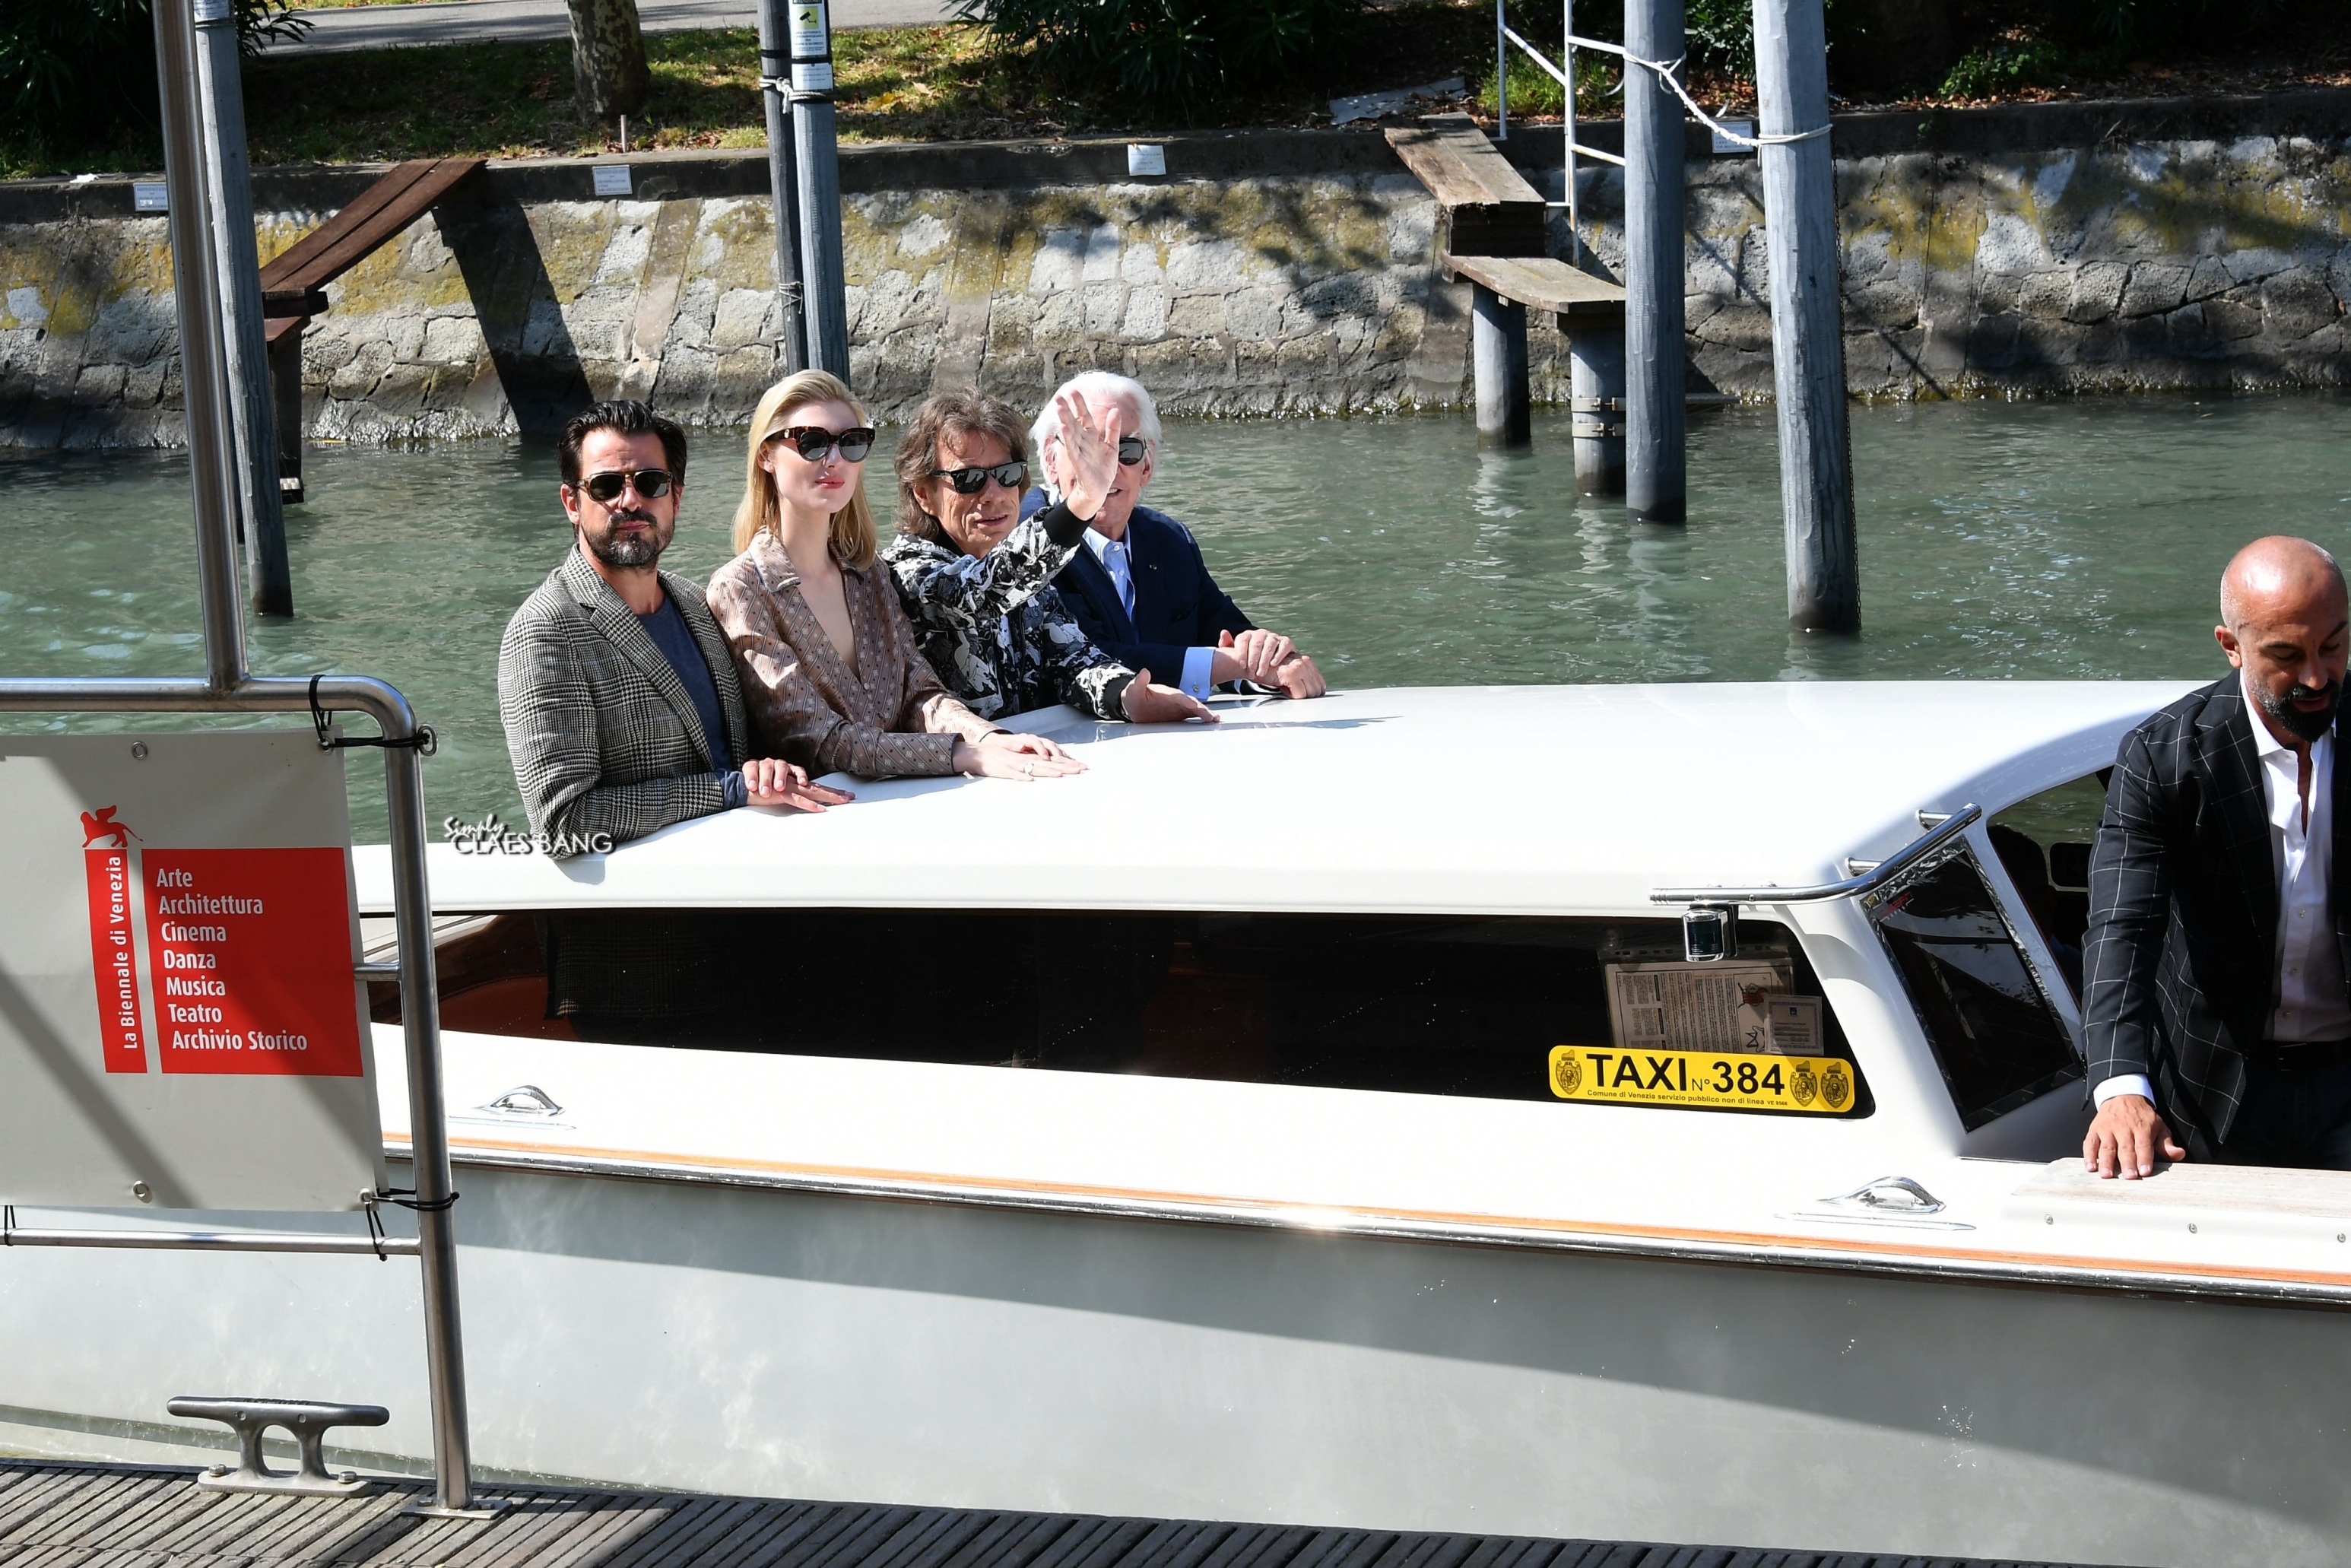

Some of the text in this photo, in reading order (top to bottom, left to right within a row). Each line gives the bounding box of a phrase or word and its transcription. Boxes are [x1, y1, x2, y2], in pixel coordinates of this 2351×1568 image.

[156, 868, 193, 887] Arte
[158, 893, 264, 915] Architettura
[160, 921, 227, 942] Cinema
[105, 856, 138, 1049] La Biennale di Venezia
[163, 949, 217, 970] Danza
[166, 975, 226, 996] Musica
[167, 1003, 223, 1023] Teatro
[172, 1028, 308, 1050] Archivio Storico
[1586, 1053, 1687, 1092] TAXI
[1712, 1061, 1785, 1096] 384
[1587, 1089, 1617, 1097] Comune
[1627, 1091, 1656, 1100] Venezia
